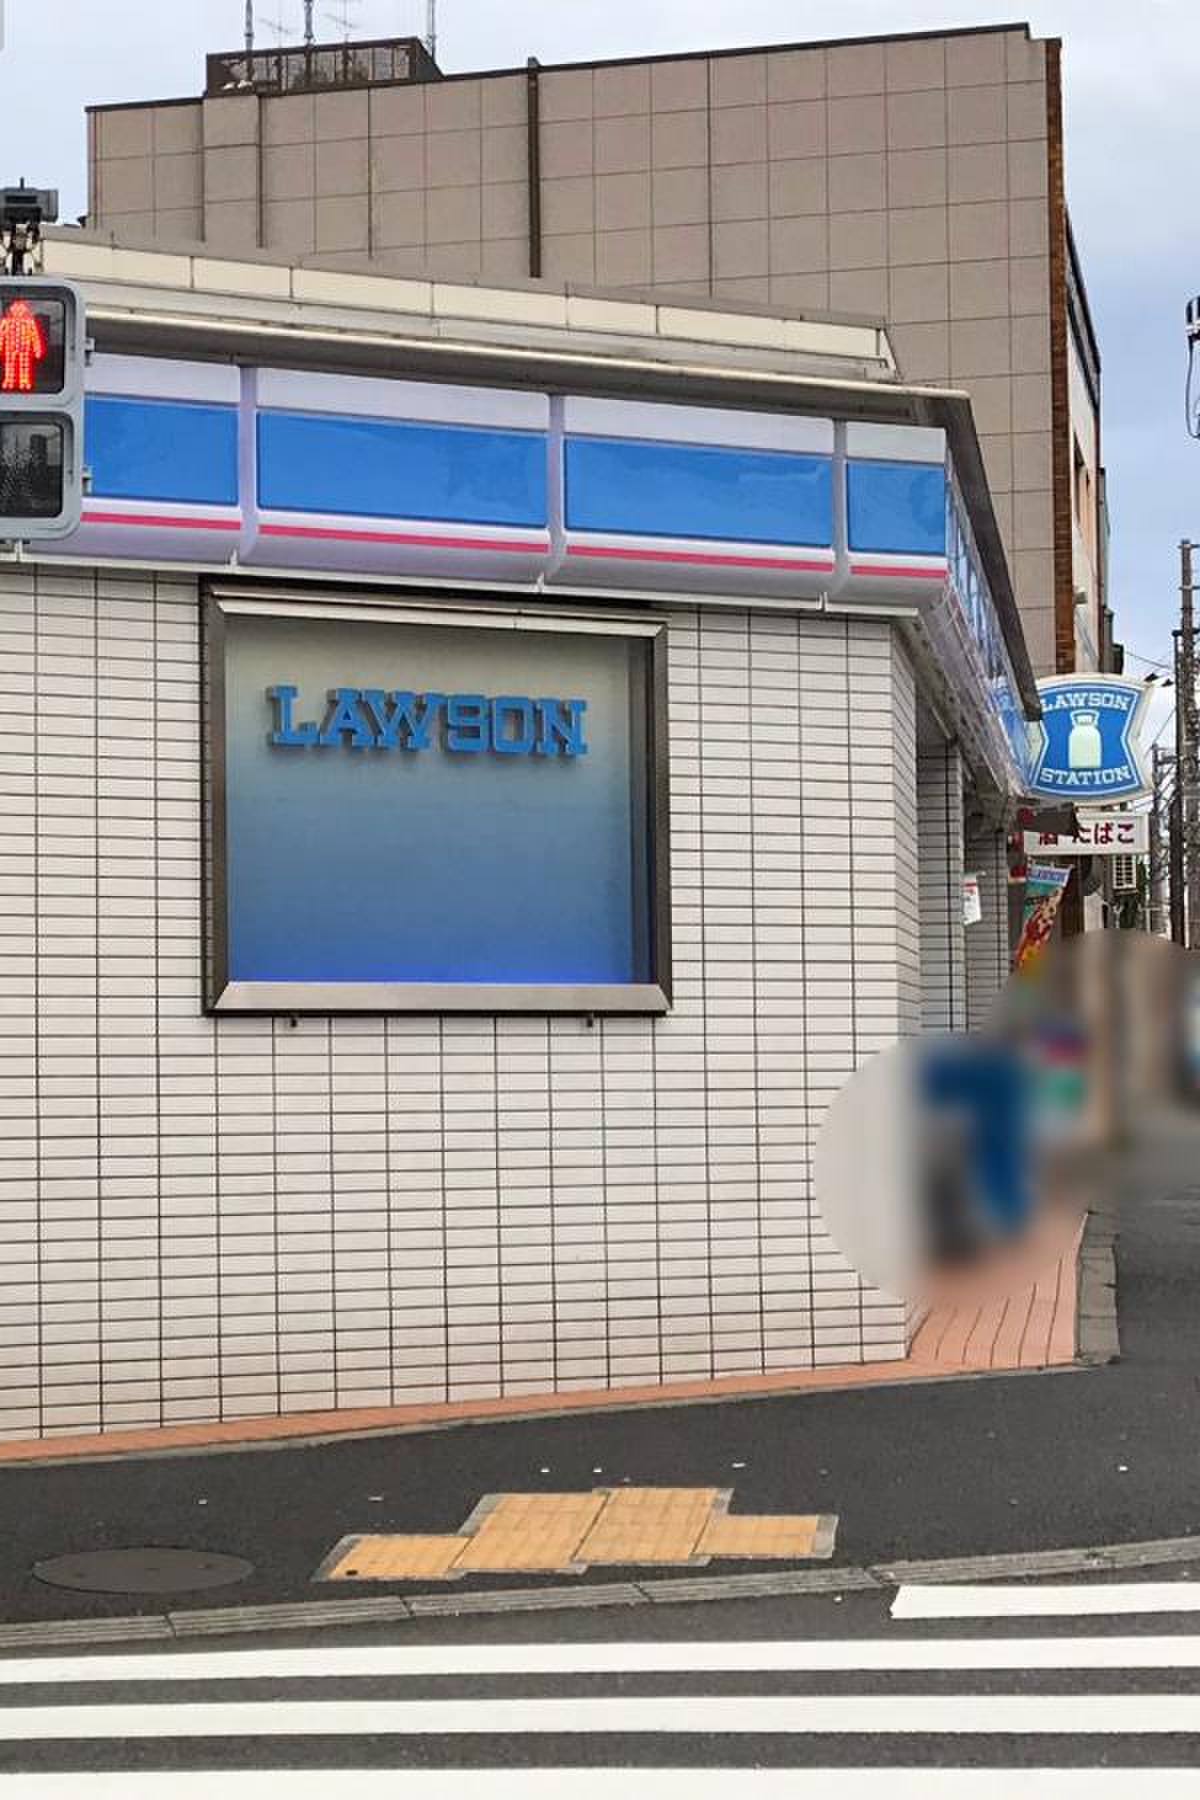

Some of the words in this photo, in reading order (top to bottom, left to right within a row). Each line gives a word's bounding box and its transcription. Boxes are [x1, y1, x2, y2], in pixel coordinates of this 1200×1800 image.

[1040, 692, 1131, 712] LAWSON
[270, 684, 588, 756] LAWSON
[1040, 765, 1131, 785] STATION
